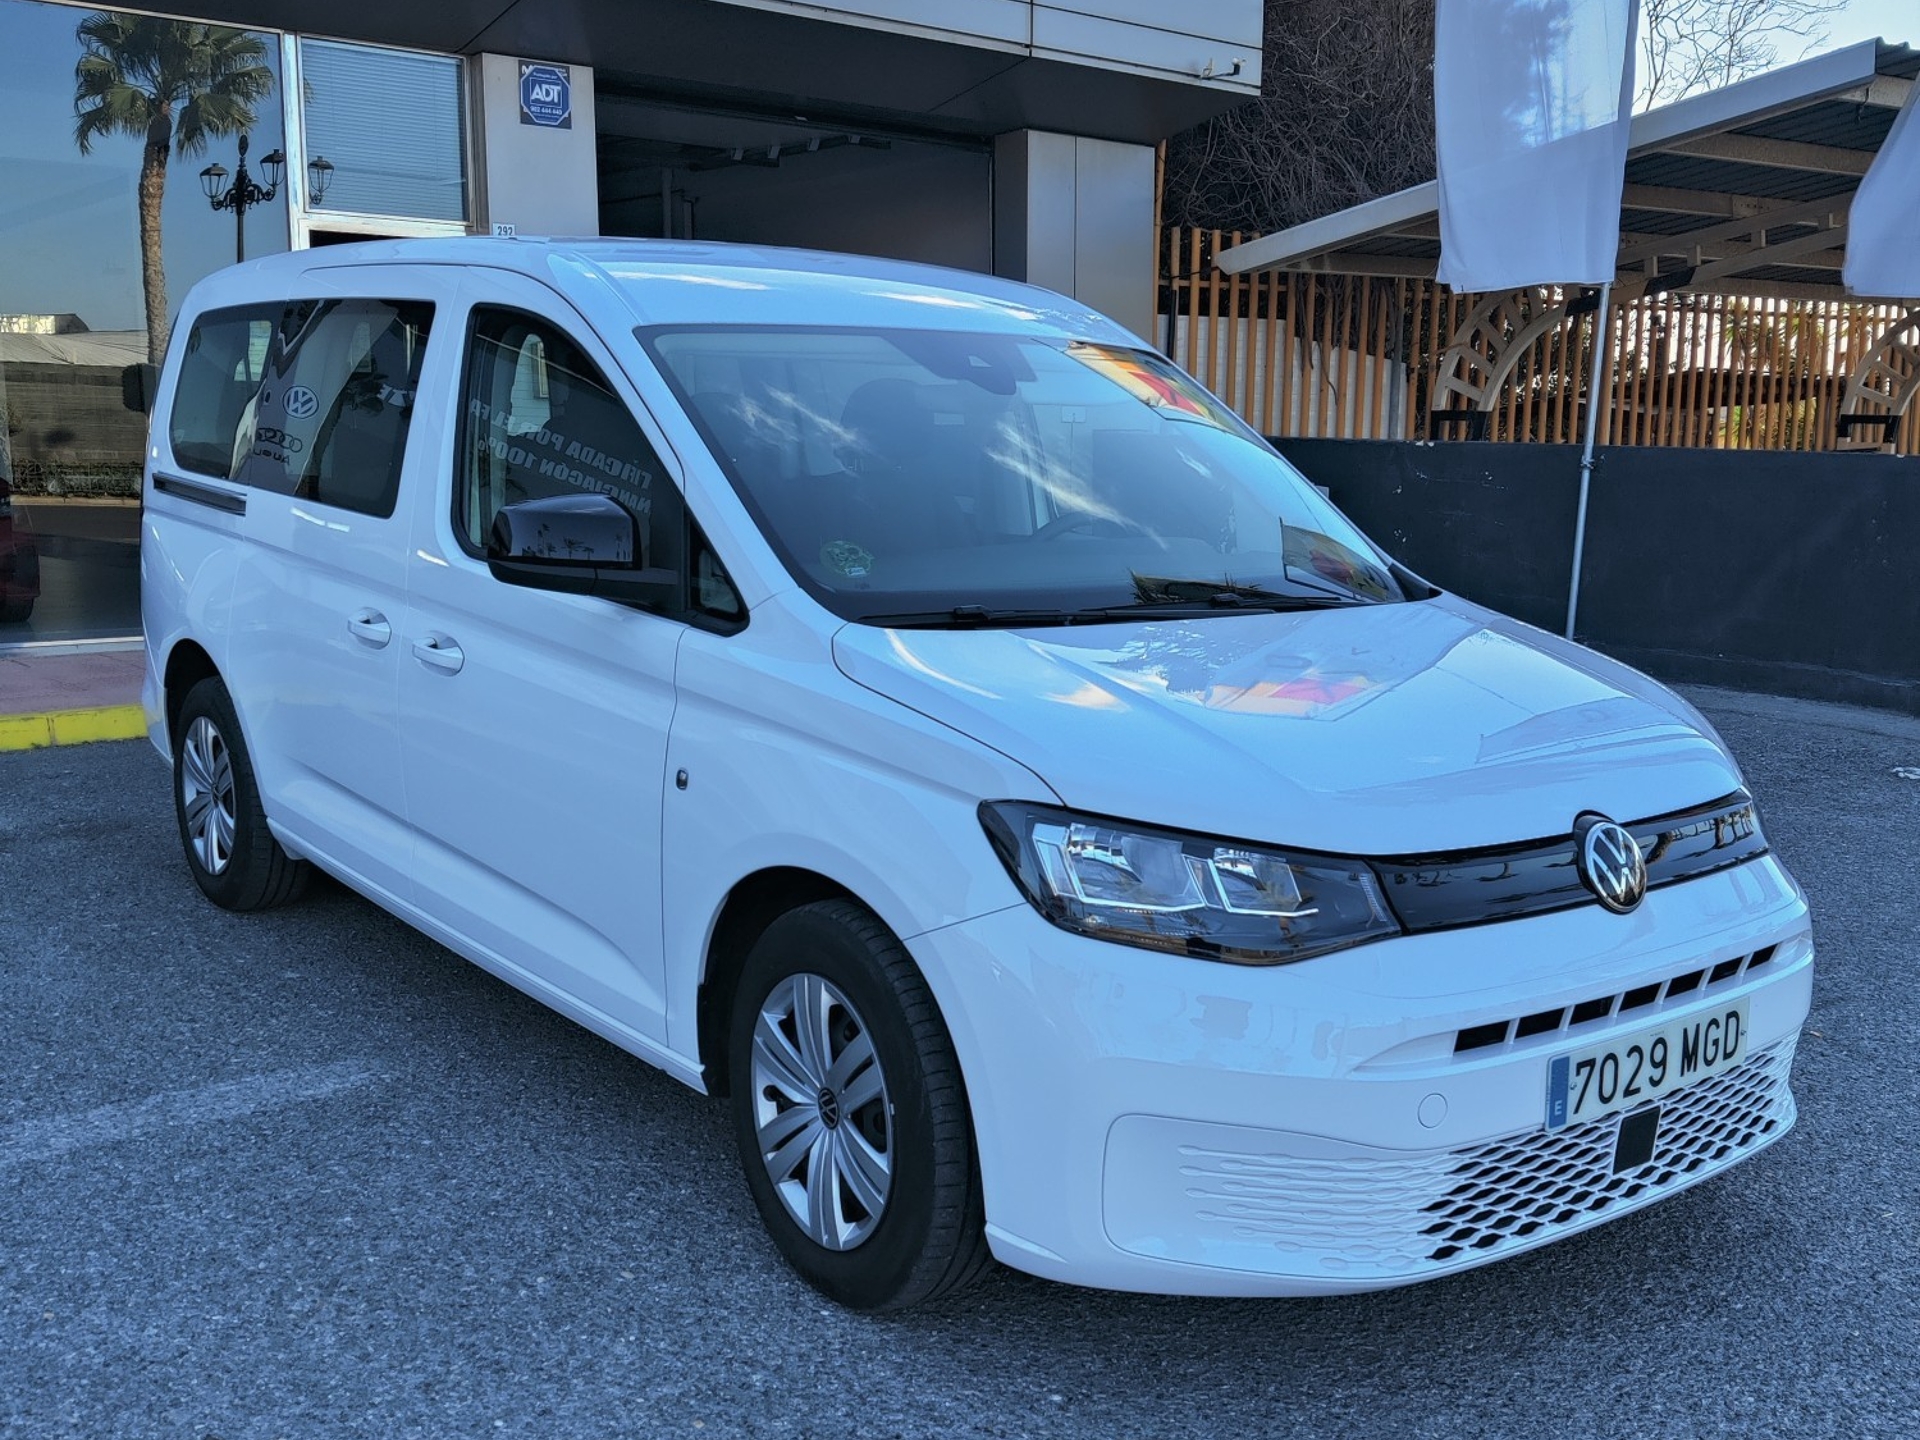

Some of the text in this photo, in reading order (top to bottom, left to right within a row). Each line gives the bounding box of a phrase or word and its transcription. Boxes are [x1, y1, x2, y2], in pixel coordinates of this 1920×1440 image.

[530, 83, 561, 103] ADT
[497, 225, 513, 236] 292
[1573, 1010, 1740, 1115] 7029 MGD
[1554, 1099, 1563, 1116] E
